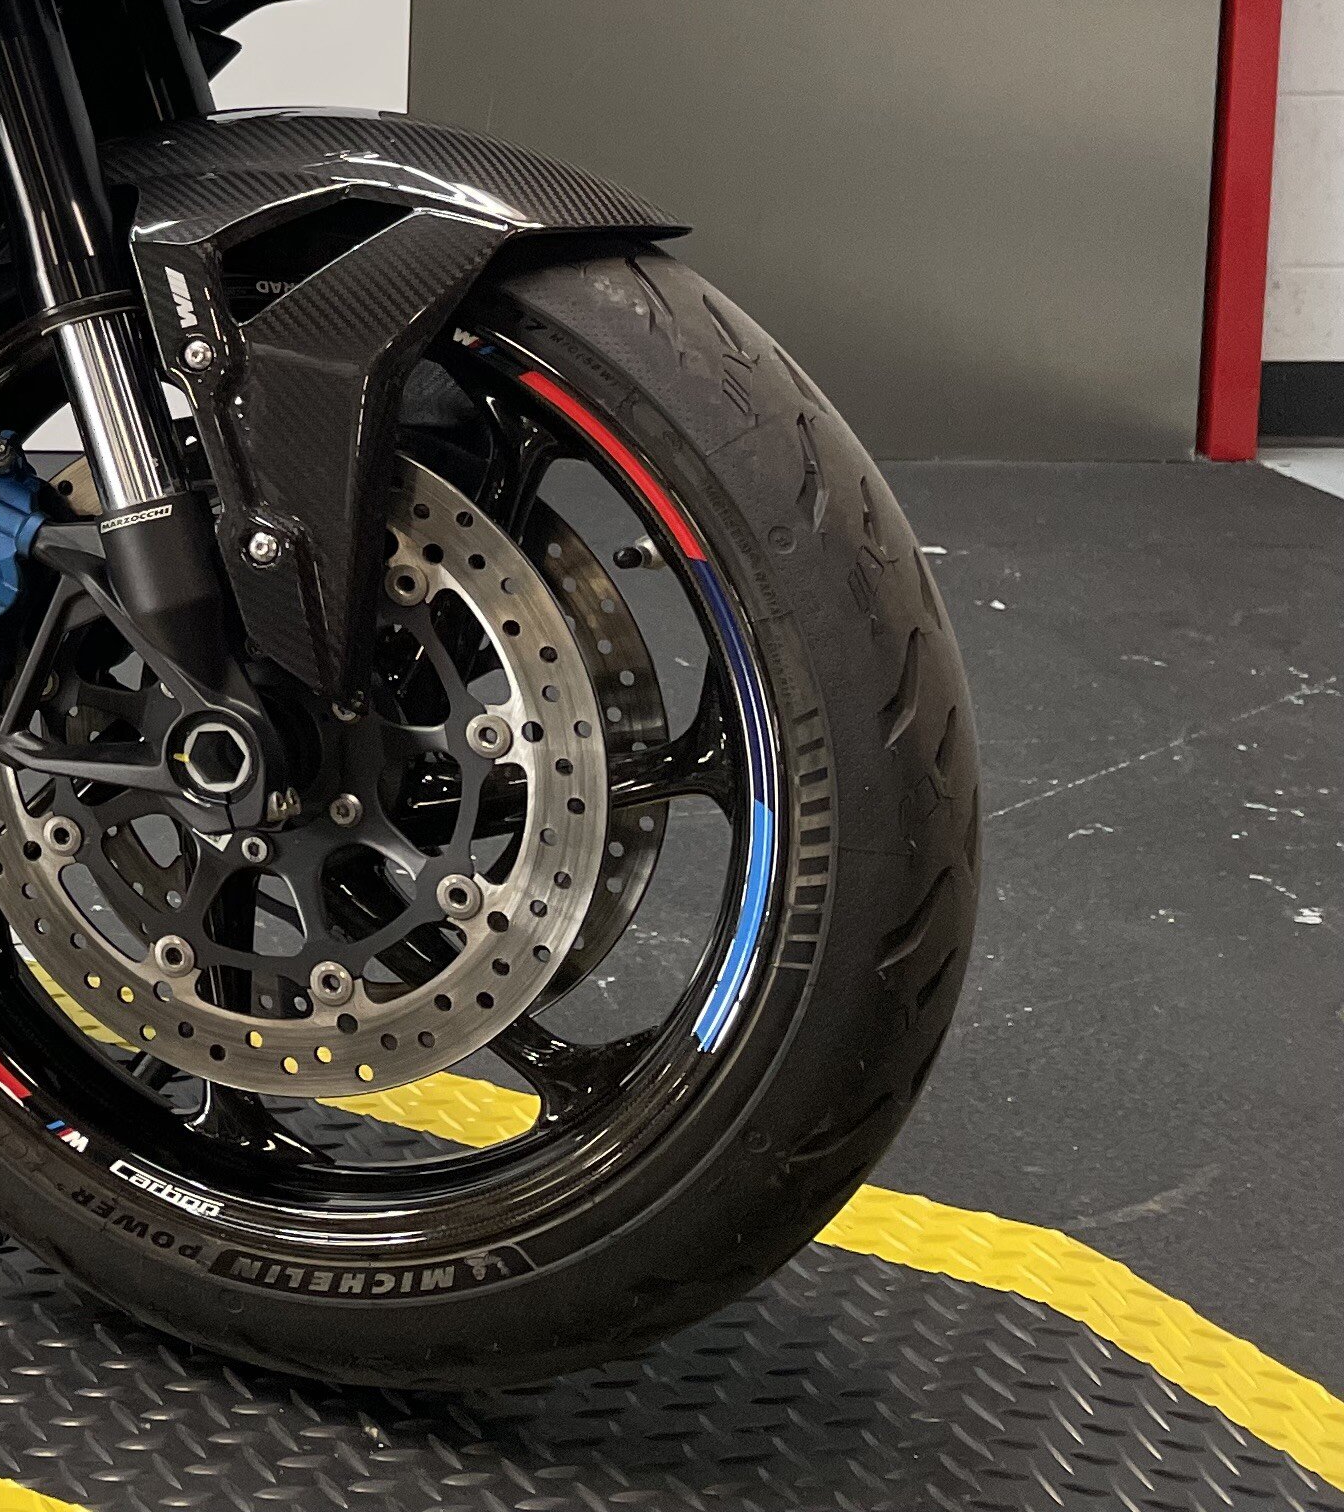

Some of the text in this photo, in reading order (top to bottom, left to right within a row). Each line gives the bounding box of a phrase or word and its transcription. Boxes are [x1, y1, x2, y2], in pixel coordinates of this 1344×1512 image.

[101, 507, 169, 530] MARZOCCHI
[109, 1159, 225, 1216] Carbon
[70, 1187, 455, 1294] MICHELIN POWER
